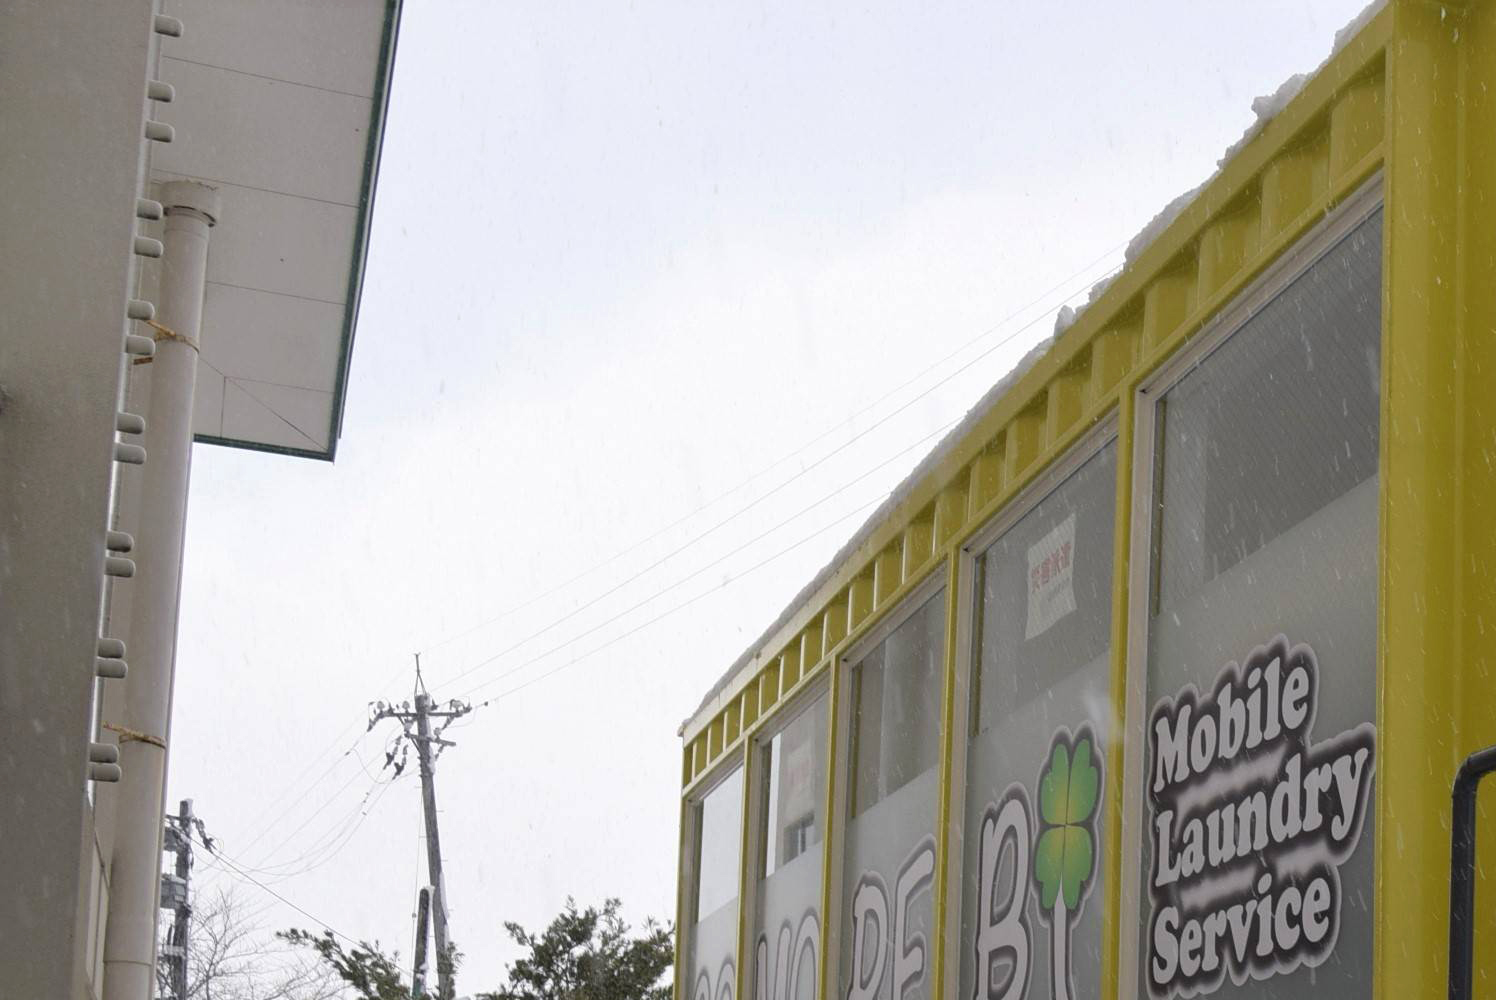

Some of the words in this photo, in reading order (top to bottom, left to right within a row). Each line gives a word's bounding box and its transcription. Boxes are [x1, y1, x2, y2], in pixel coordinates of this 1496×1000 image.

[1152, 655, 1311, 794] Mobile
[1155, 746, 1370, 888] Laundry
[1152, 872, 1332, 986] Service
